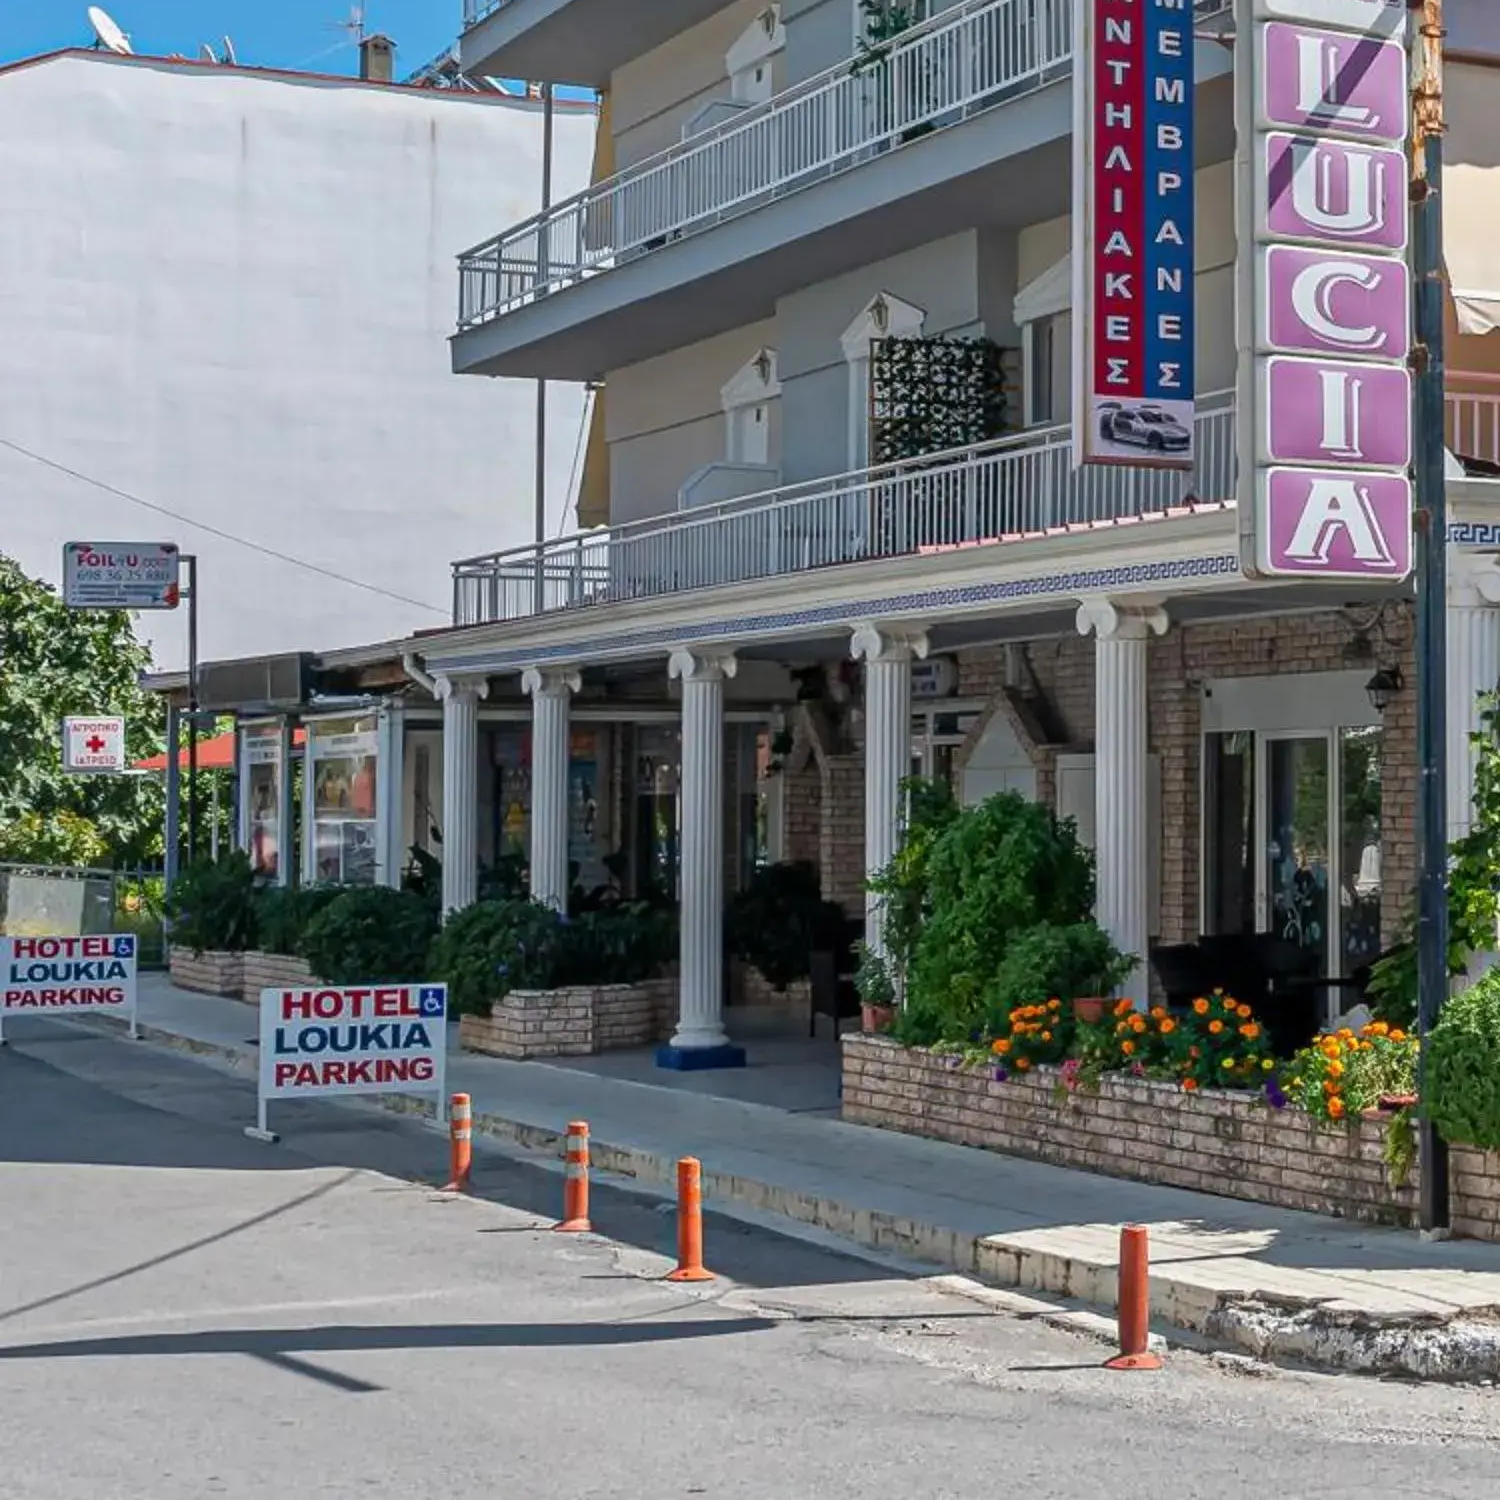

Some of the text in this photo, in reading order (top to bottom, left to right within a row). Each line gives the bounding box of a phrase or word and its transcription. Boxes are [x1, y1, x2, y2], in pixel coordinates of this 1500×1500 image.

[1283, 34, 1398, 567] LUCIA
[14, 937, 115, 958] HOTEL
[10, 961, 128, 983] LOUKIA
[5, 987, 124, 1007] PARKING
[282, 988, 420, 1020] HOTEL
[274, 1023, 432, 1054] LOUKIA
[275, 1057, 433, 1088] PARKING
